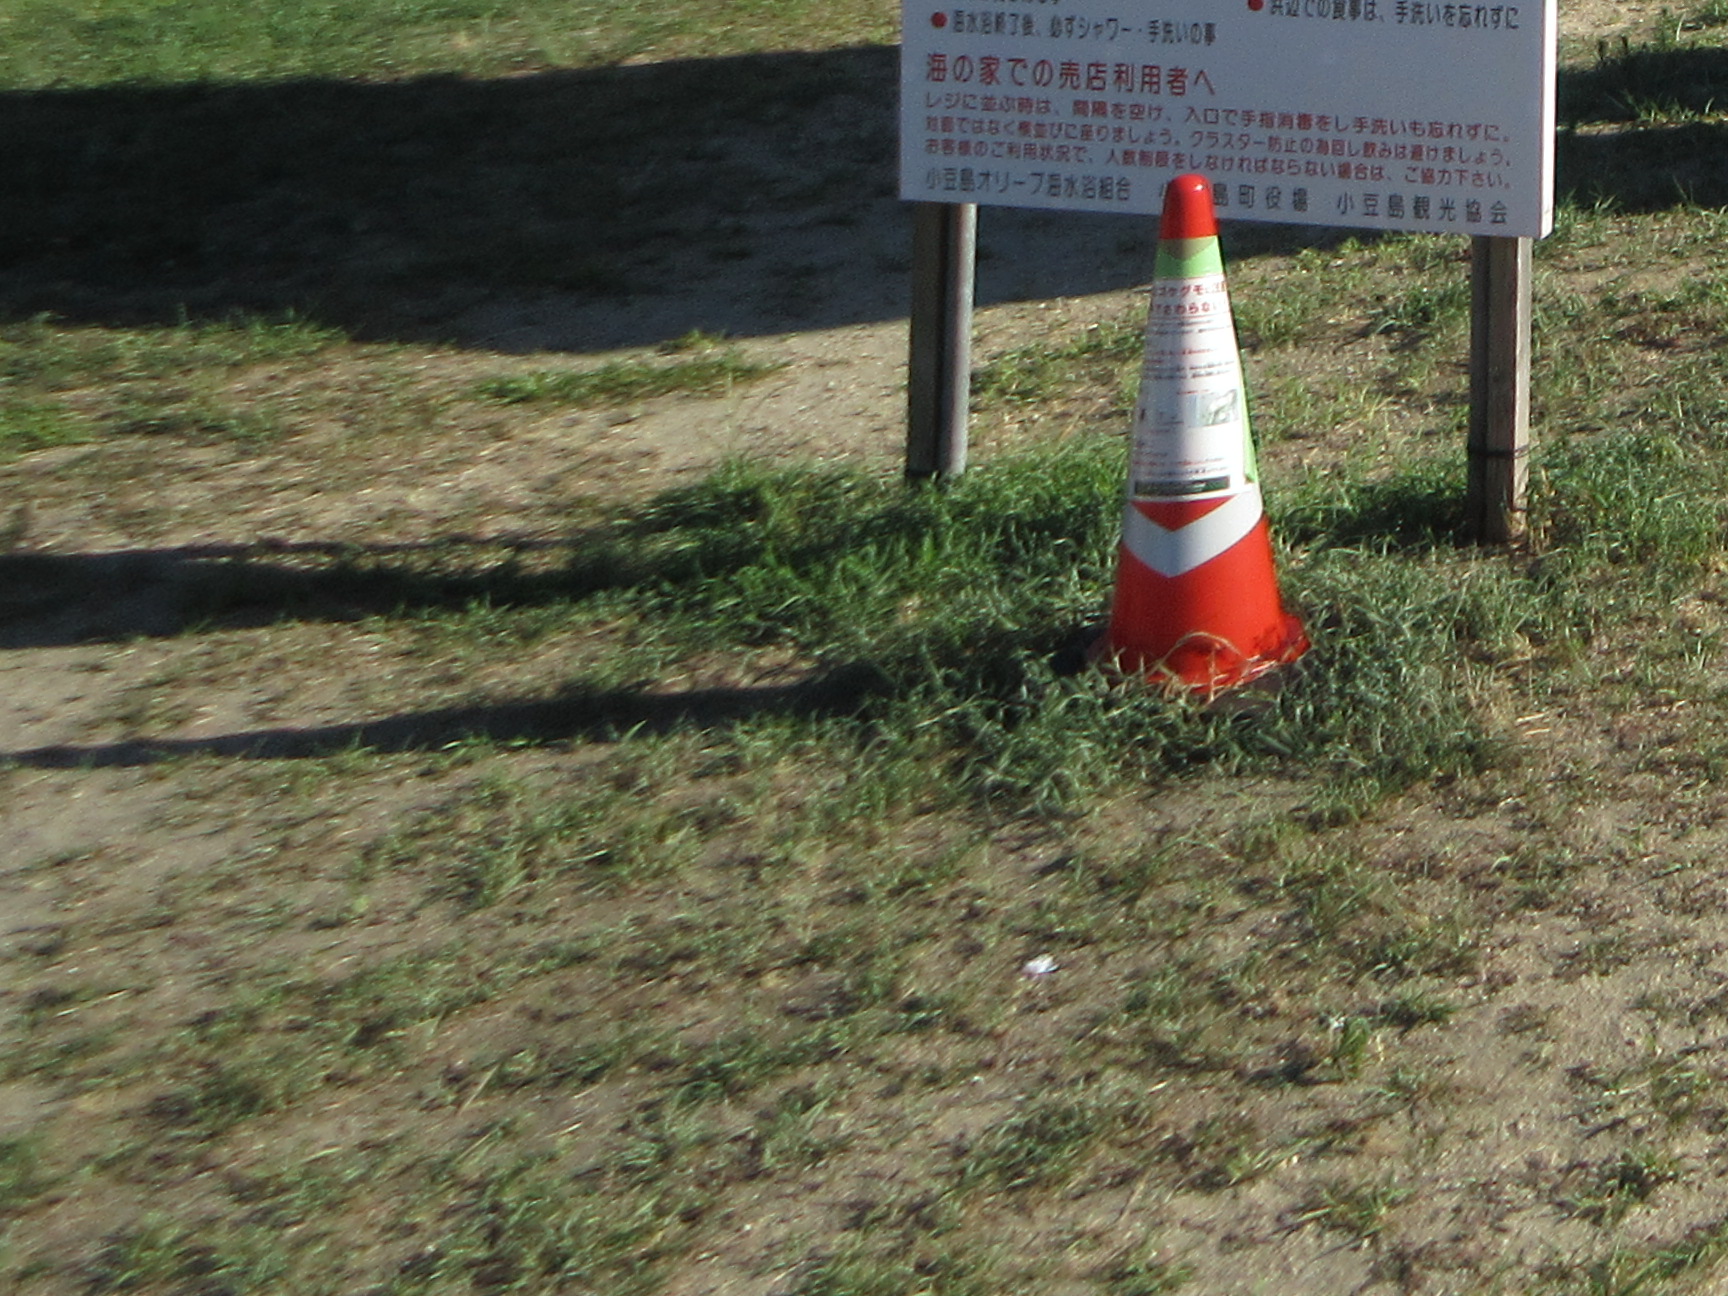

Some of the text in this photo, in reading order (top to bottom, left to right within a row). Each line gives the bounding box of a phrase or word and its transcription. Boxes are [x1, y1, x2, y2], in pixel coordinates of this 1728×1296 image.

[925, 52, 1215, 97] 海の家での売店利用者へ
[1336, 191, 1509, 225] 小豆島観光協会
